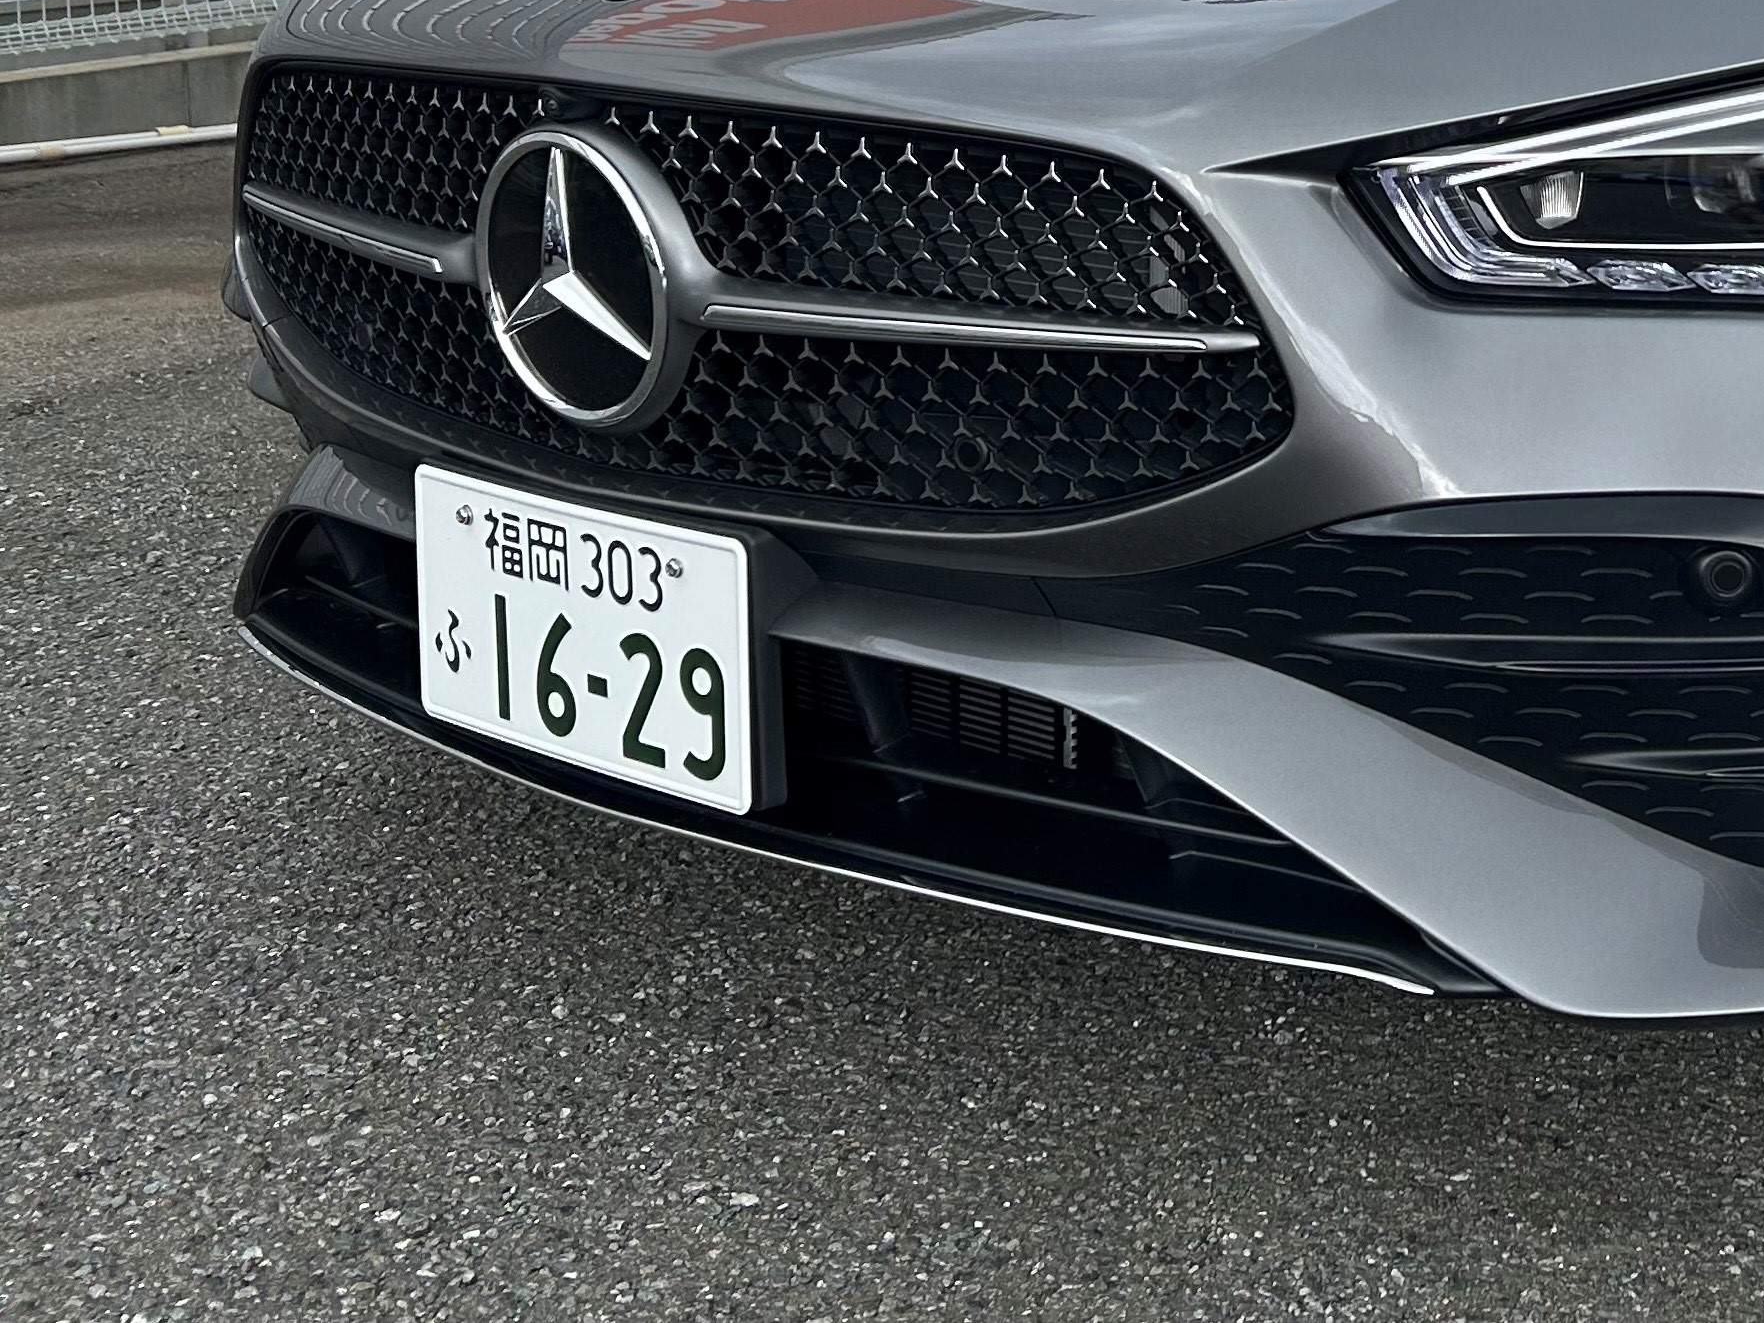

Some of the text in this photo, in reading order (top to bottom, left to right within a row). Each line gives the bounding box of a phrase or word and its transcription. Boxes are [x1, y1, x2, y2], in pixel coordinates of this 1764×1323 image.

[484, 508, 664, 612] 福岡 303
[435, 594, 726, 781] ふ 16-29
